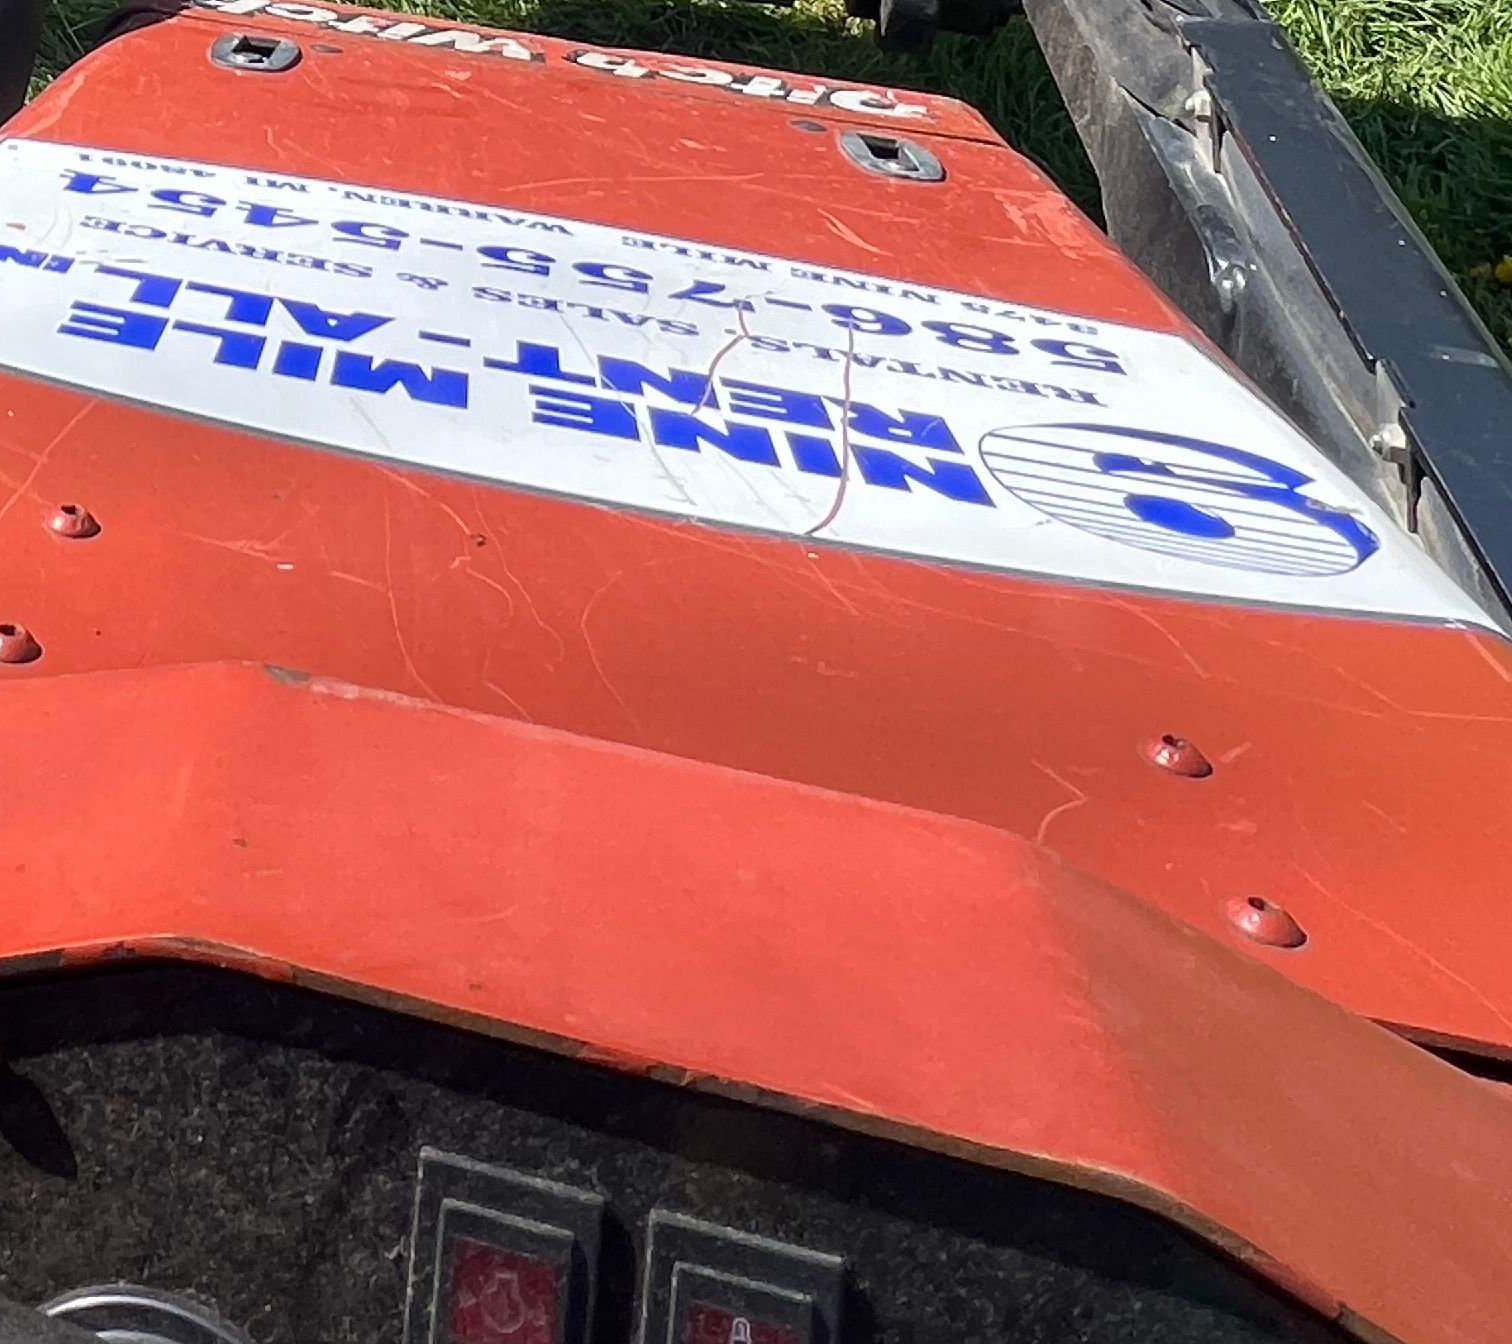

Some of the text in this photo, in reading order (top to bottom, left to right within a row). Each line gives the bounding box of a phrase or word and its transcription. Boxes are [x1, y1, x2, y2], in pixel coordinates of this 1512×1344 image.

[563, 49, 935, 119] Ditch
[243, 175, 311, 194] MI
[58, 168, 1128, 377] 586-755-5454
[79, 214, 374, 279] SERVICE
[622, 236, 774, 271] MILE
[396, 271, 450, 292] &
[472, 284, 700, 337] SALES
[790, 266, 943, 306] NINE
[94, 263, 967, 453] RENT-ALL
[56, 299, 996, 508] NINE MILE
